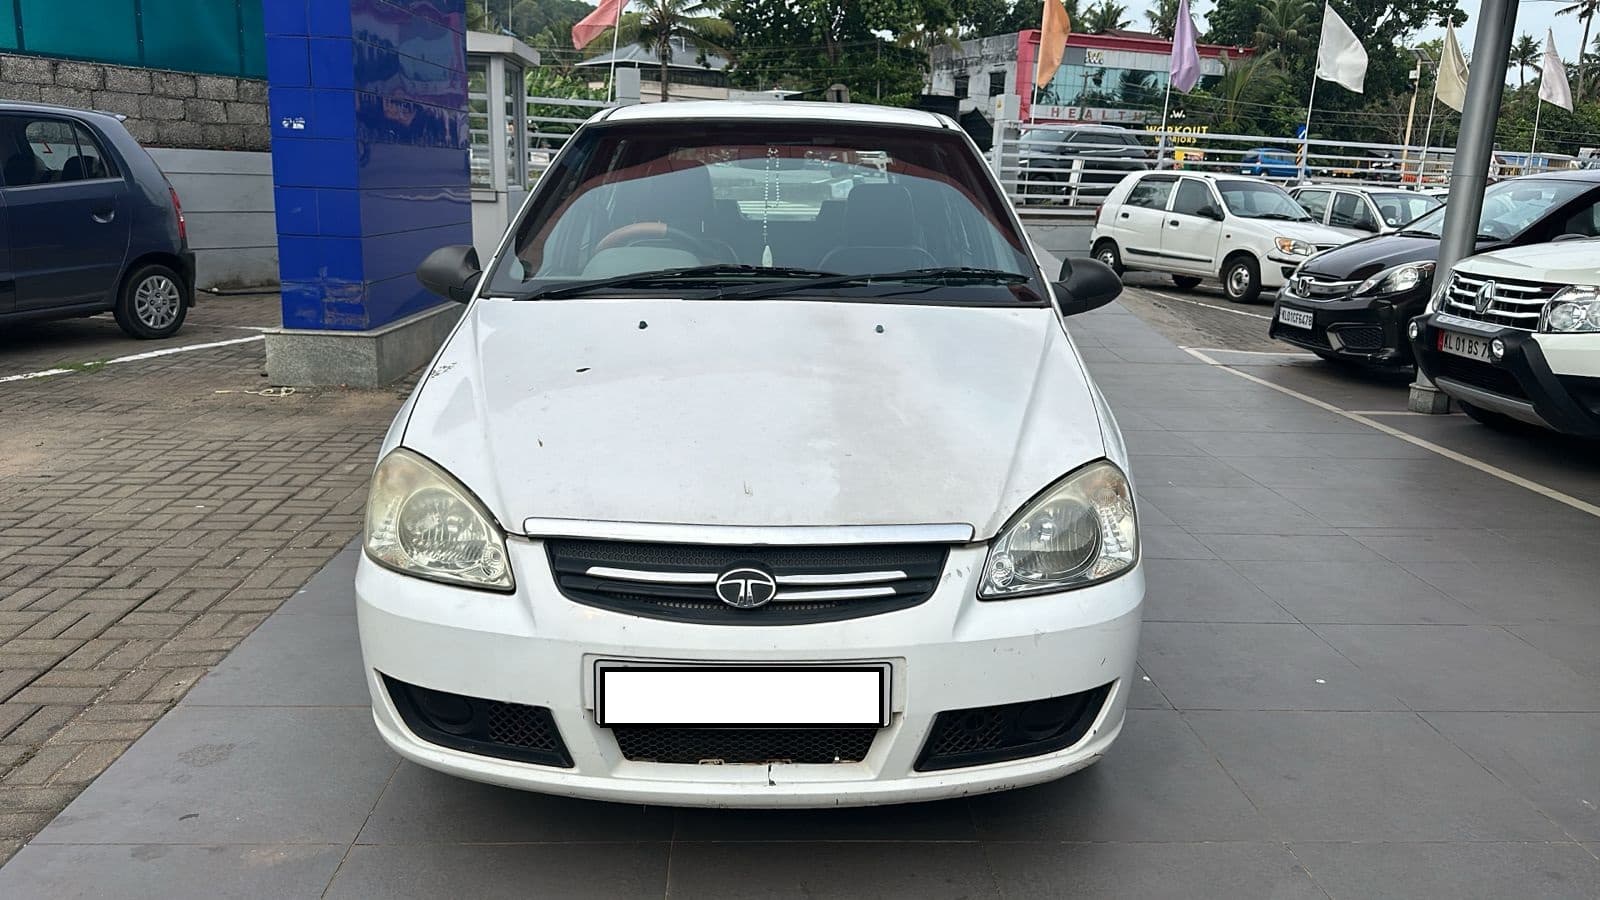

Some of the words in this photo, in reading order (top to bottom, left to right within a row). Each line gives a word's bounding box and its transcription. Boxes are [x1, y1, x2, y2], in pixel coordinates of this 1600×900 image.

[1051, 107, 1143, 120] HEALTH
[1155, 135, 1197, 144] WRIORS
[1456, 337, 1465, 352] 01
[1468, 340, 1479, 355] BS
[1481, 343, 1490, 358] 7
